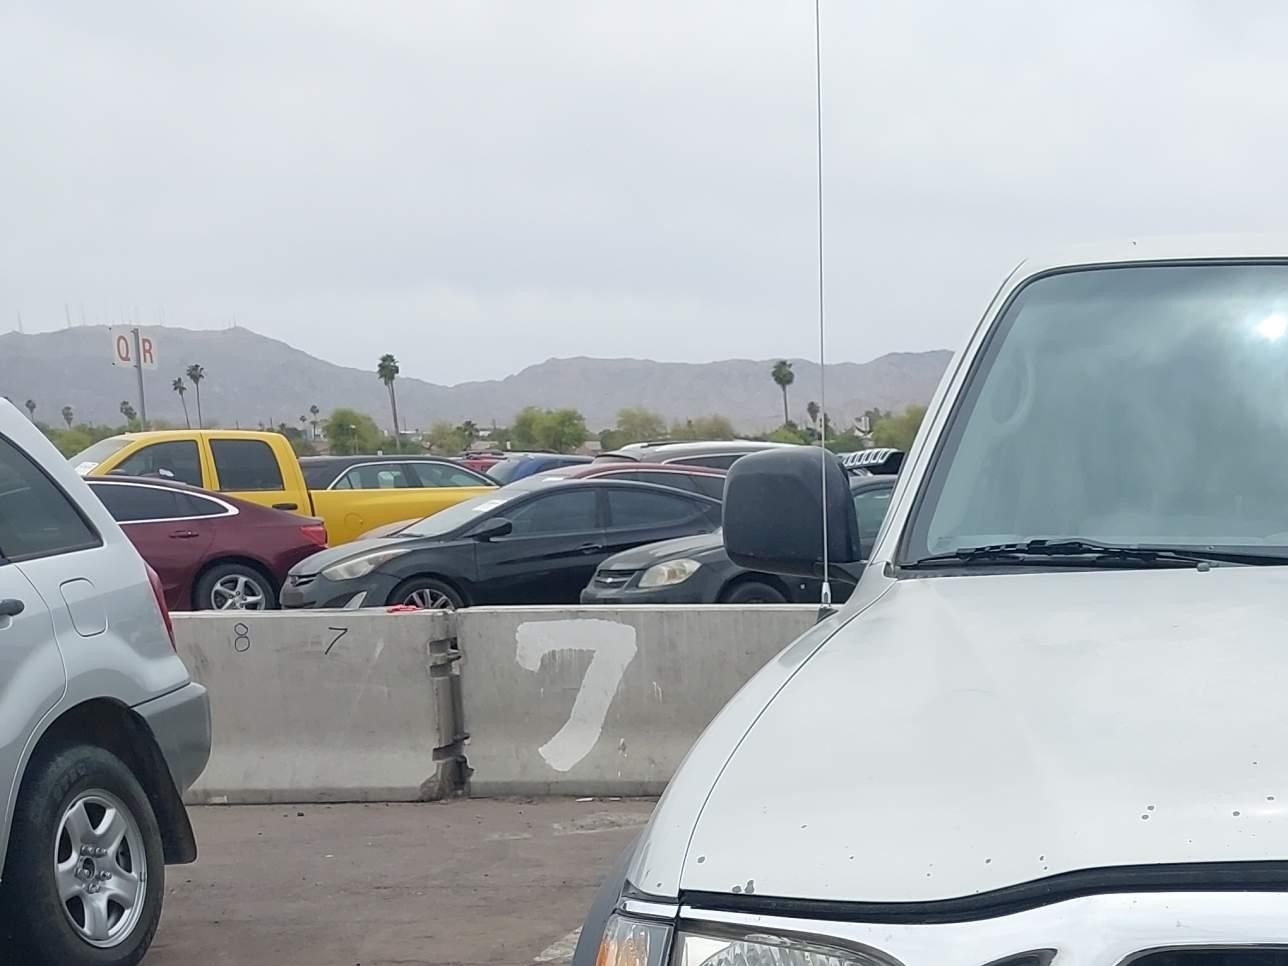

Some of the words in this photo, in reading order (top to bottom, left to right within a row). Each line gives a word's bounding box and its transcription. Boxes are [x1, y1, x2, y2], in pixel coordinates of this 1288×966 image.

[117, 335, 130, 361] Q
[141, 338, 154, 364] R
[234, 622, 250, 652] 8
[324, 627, 348, 655] 7
[516, 618, 636, 771] 7
